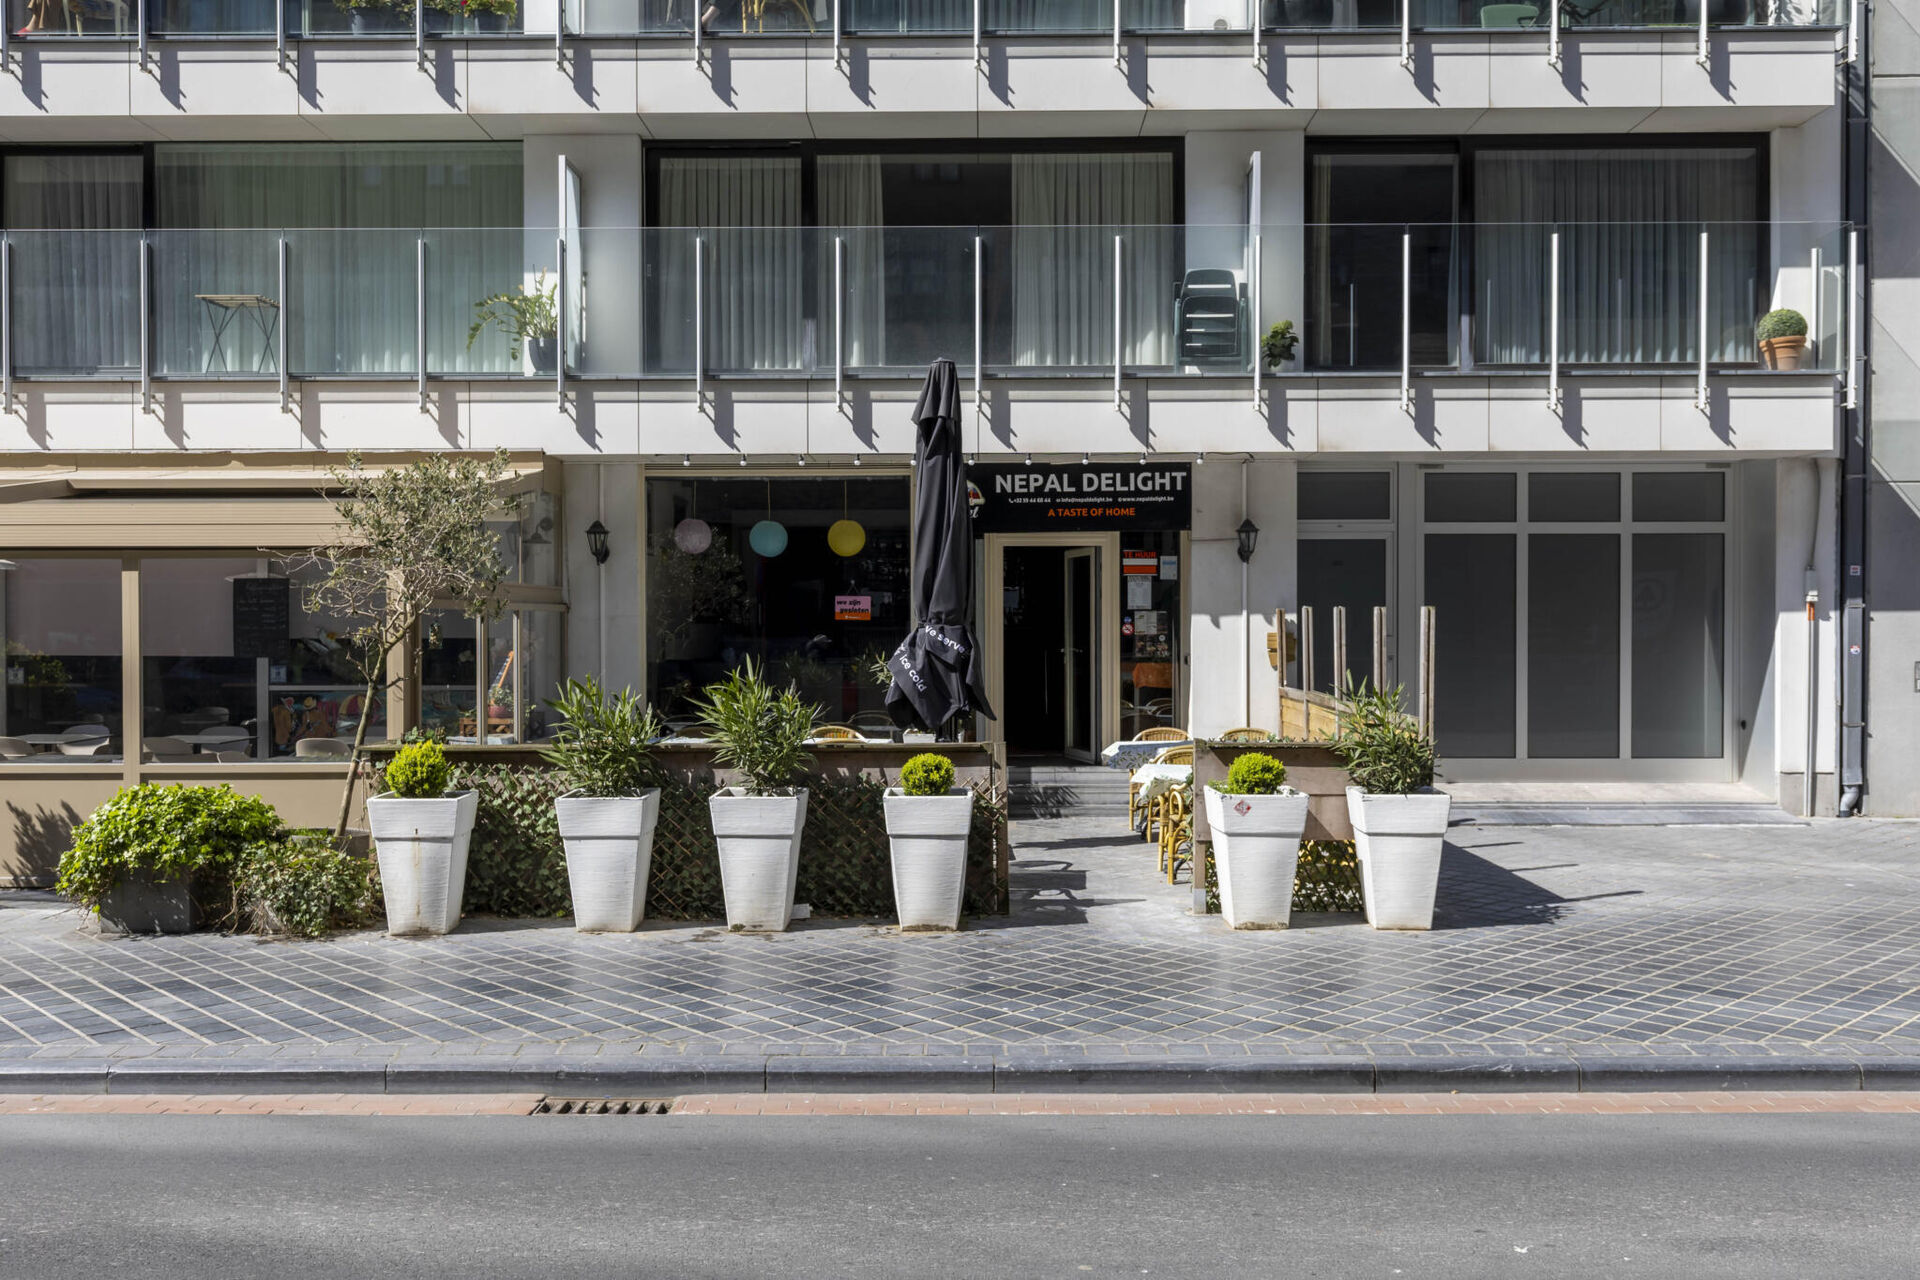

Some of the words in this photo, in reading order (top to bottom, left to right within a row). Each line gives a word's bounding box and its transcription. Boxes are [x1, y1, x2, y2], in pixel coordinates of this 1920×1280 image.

[995, 473, 1076, 493] NEPAL
[1082, 471, 1187, 492] DELIGHT
[1048, 508, 1056, 517] A
[1056, 508, 1088, 517] TASTE
[1090, 508, 1104, 516] OF
[1105, 507, 1136, 516] HOME
[1123, 551, 1133, 559] TE
[909, 669, 927, 692] cold
